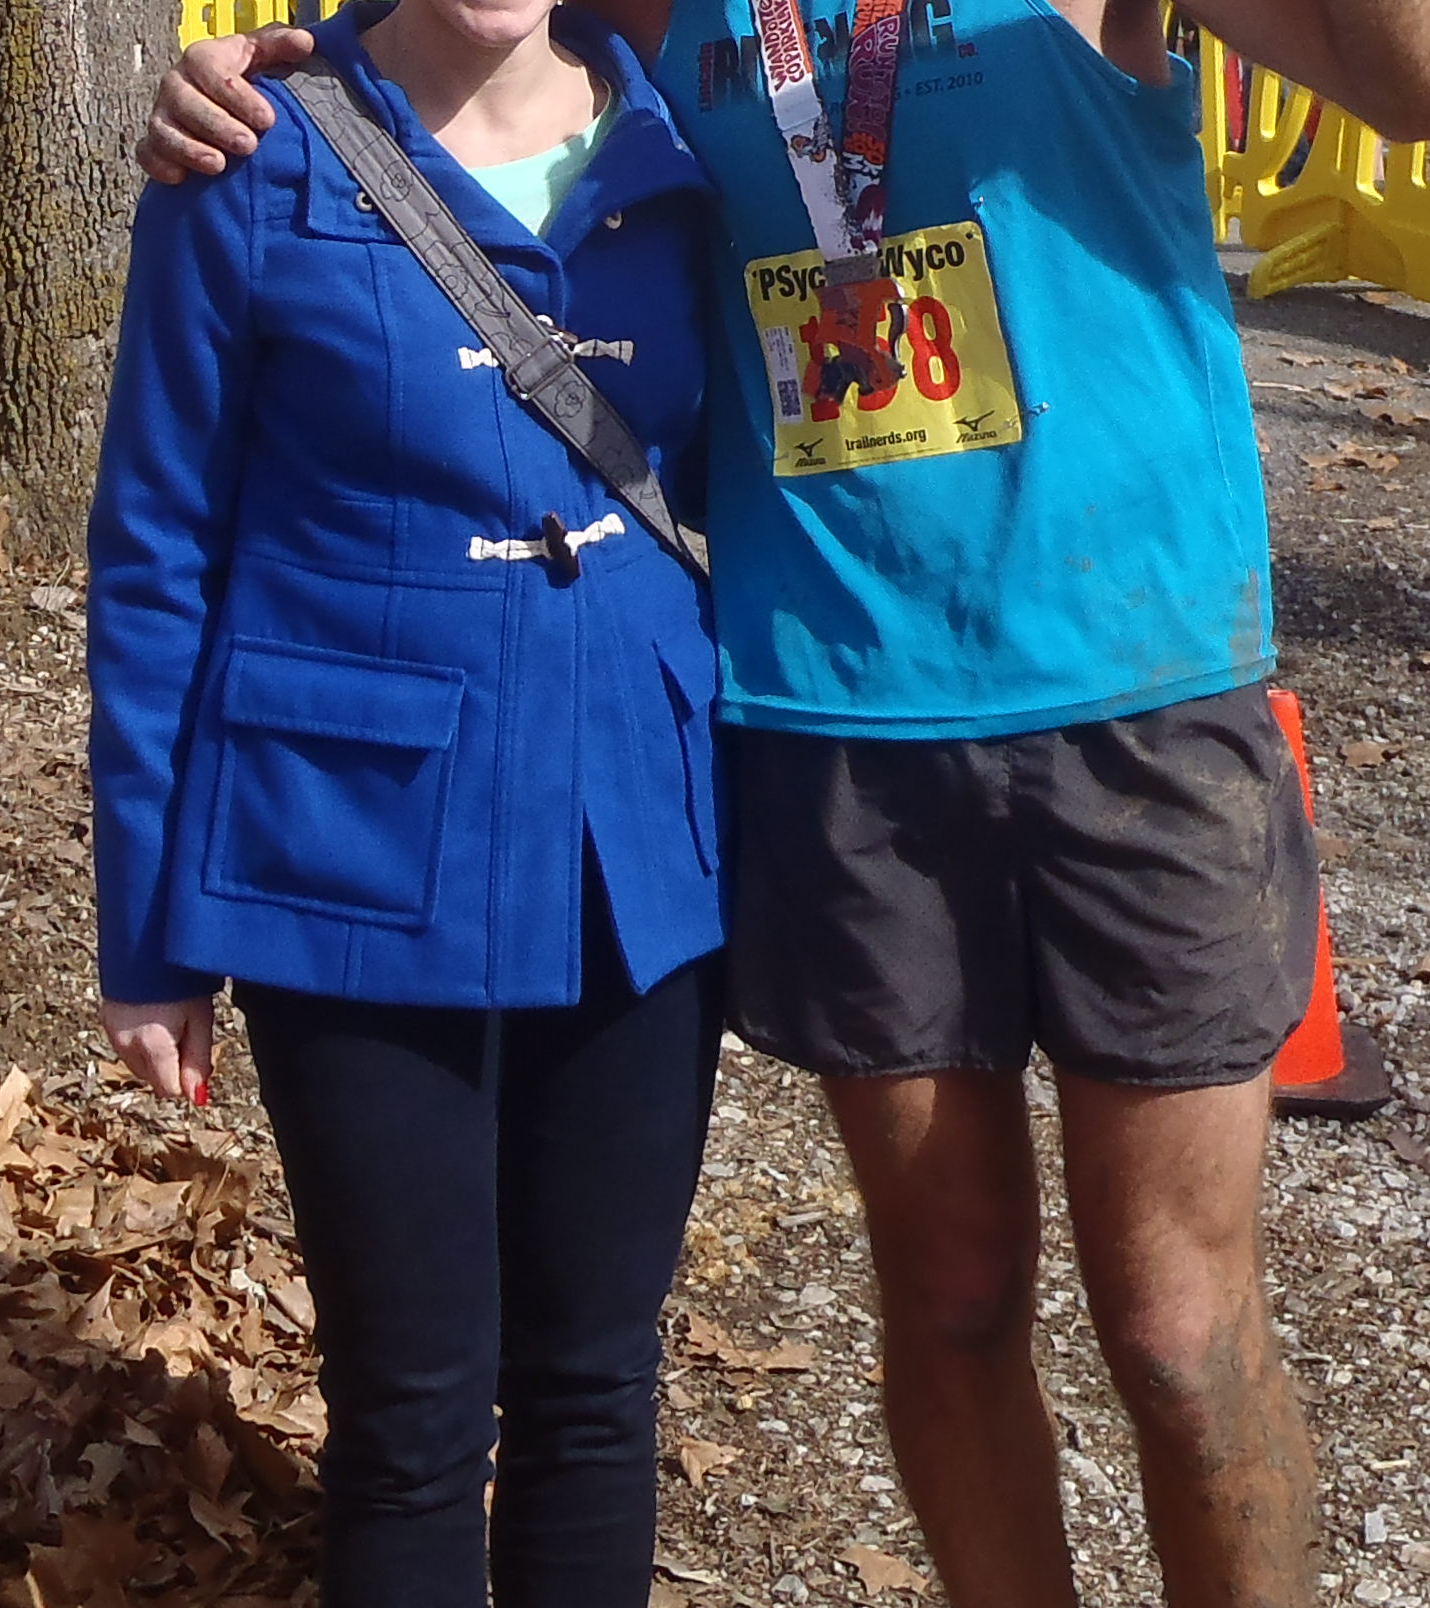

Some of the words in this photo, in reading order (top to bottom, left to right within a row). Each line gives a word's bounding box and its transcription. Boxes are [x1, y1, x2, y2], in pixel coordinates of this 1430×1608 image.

[915, 76, 945, 95] EST.
[947, 71, 983, 90] 2010
[759, 264, 826, 301] PSyc
[879, 240, 965, 281] Wyco
[845, 428, 927, 452] trailnerds.org
